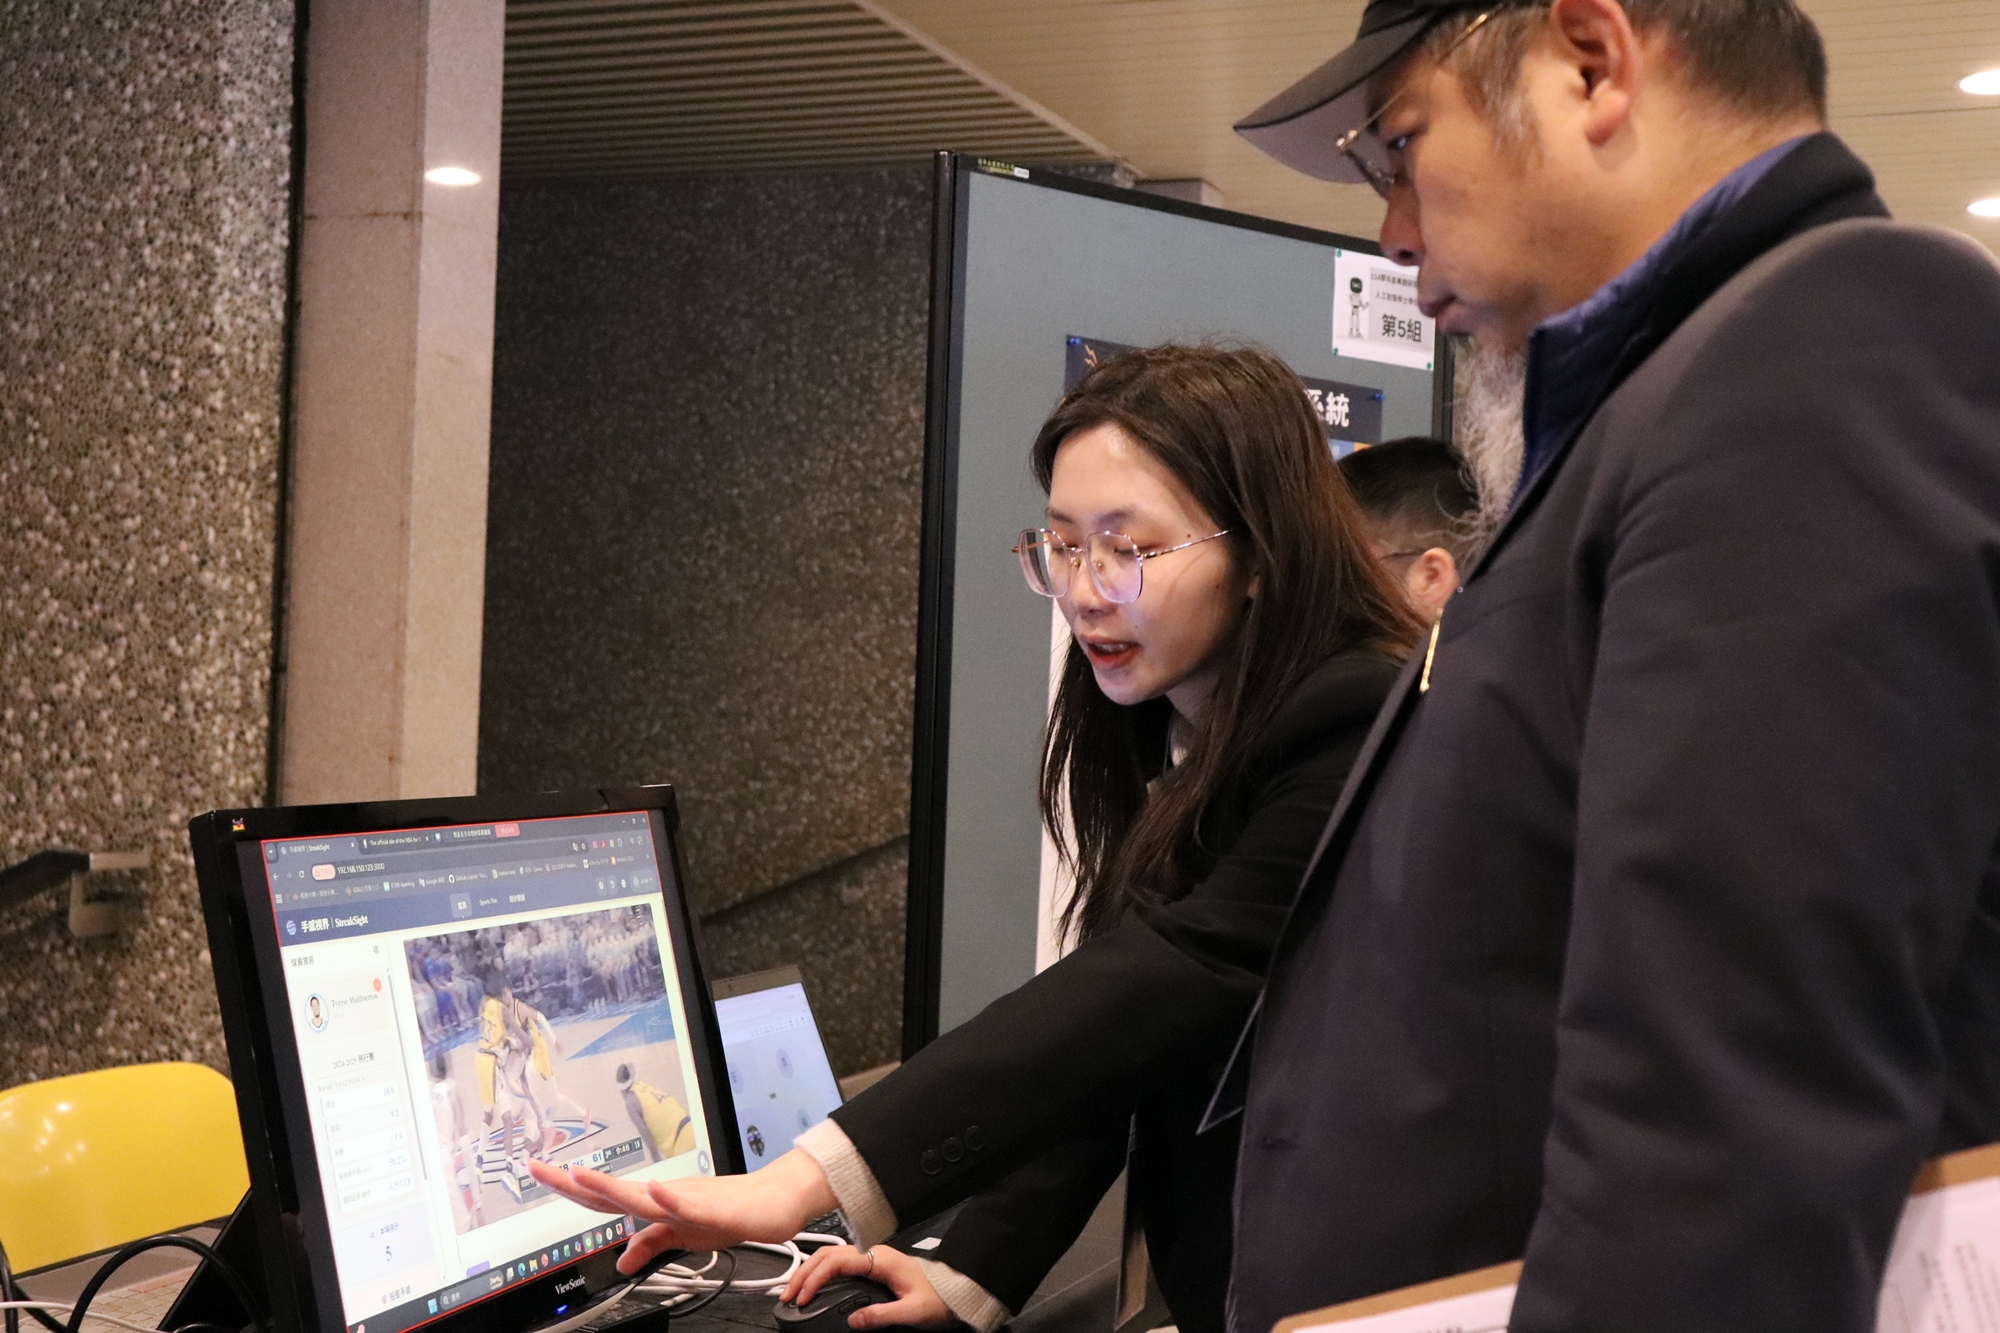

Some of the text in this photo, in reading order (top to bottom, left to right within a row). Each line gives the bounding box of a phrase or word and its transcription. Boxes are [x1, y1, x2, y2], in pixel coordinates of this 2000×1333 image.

[1382, 314, 1422, 342] 第5組
[1306, 388, 1349, 428] 系統
[309, 844, 330, 852] StreakSight
[337, 862, 385, 874] 192.168.150.123:3000
[301, 915, 368, 933] 手感視界 StreakSight
[291, 956, 315, 968] 球員資訊
[332, 993, 378, 1009] Tyrese Haliburton
[318, 1076, 365, 1092] BASIC STATISTICS
[383, 1086, 395, 1096] 18.6
[592, 1152, 602, 1162] 61
[616, 1144, 630, 1155] 9:46
[386, 1245, 392, 1262] 5
[555, 1275, 586, 1295] ViewSonic
